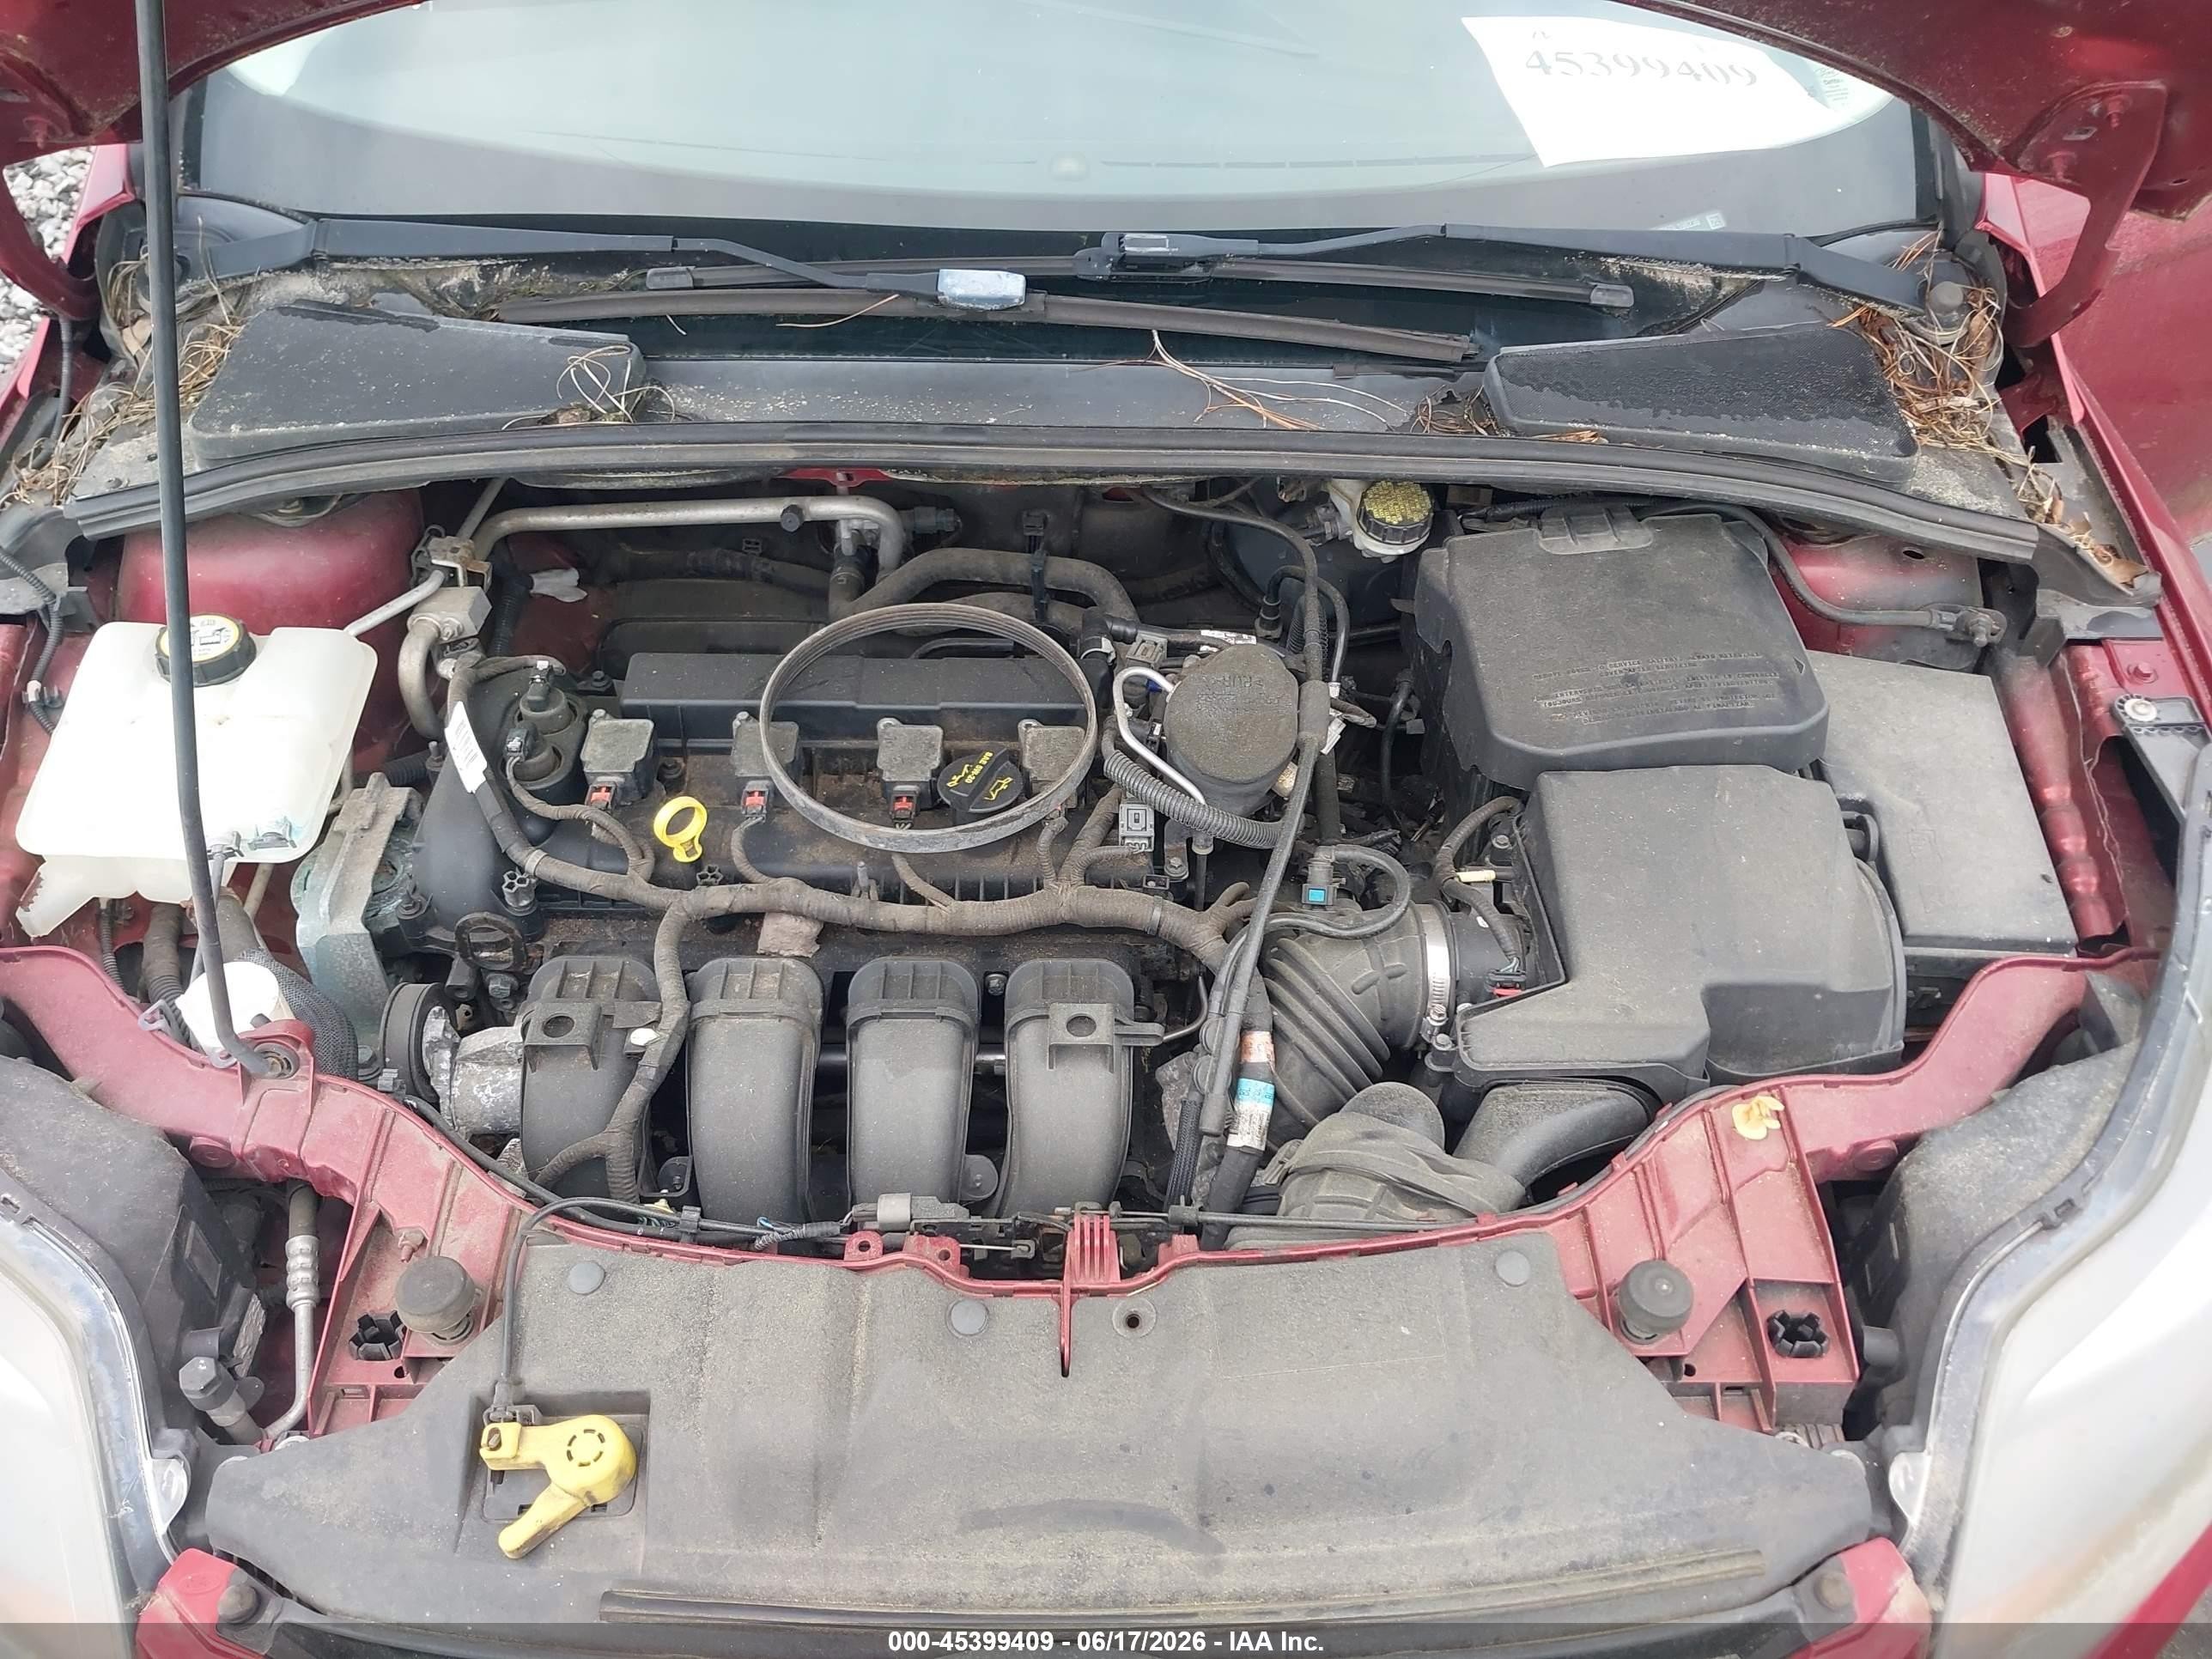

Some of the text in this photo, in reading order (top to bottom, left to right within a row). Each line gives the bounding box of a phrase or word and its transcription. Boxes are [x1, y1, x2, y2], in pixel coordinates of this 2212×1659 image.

[1525, 49, 1759, 87] 45399409
[964, 751, 994, 784] SAE 5W-20
